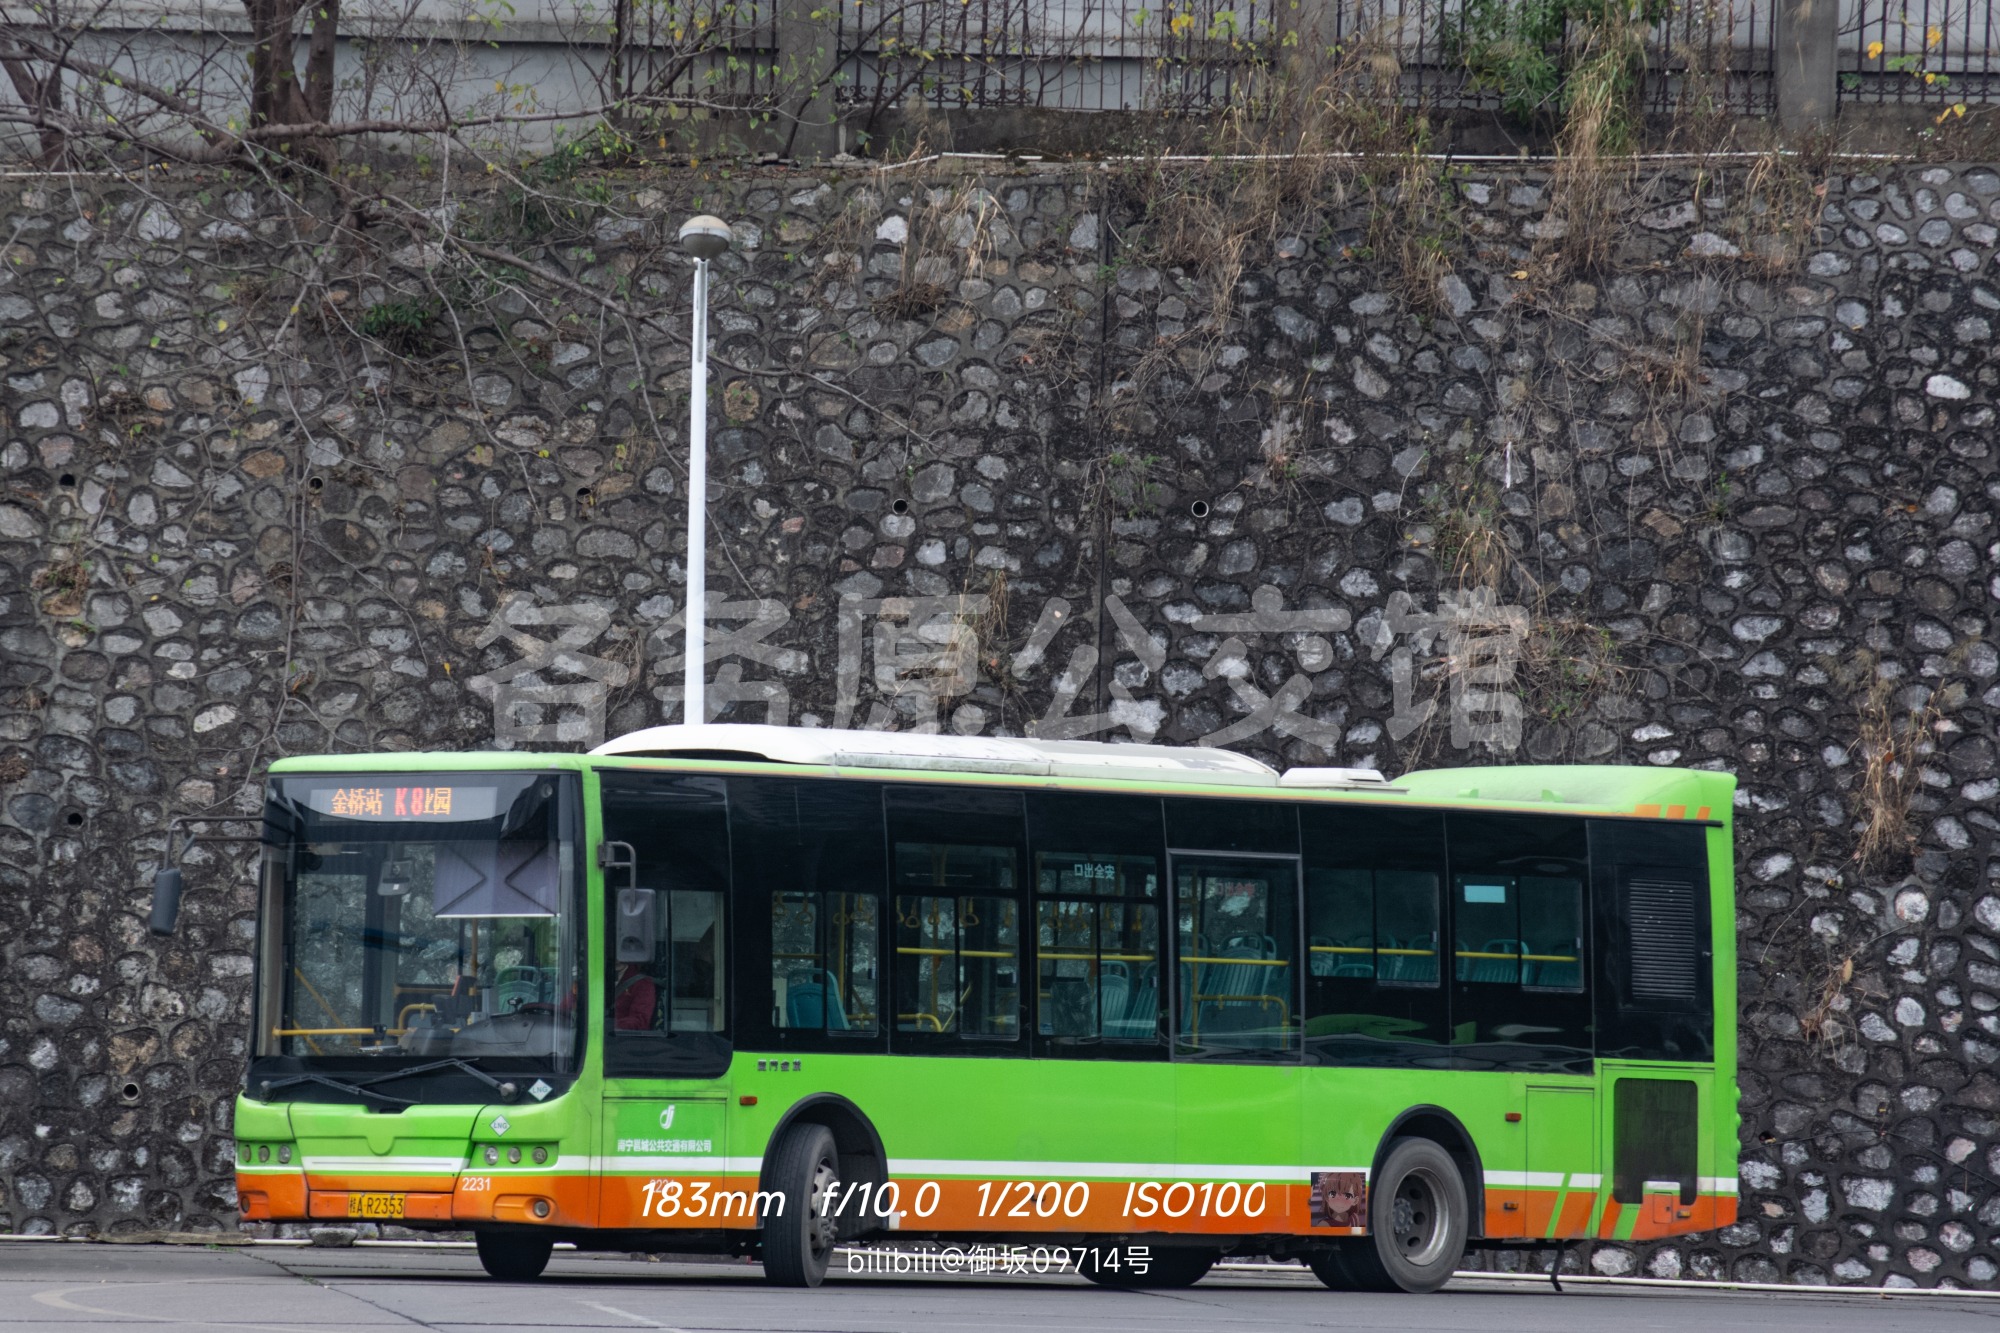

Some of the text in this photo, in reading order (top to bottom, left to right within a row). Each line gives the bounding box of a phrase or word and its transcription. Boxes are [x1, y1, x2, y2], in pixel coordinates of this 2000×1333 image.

[331, 787, 384, 816] 金桥站
[532, 1086, 549, 1094] LNG
[493, 1122, 508, 1130] LNG
[462, 1177, 491, 1192] 2231
